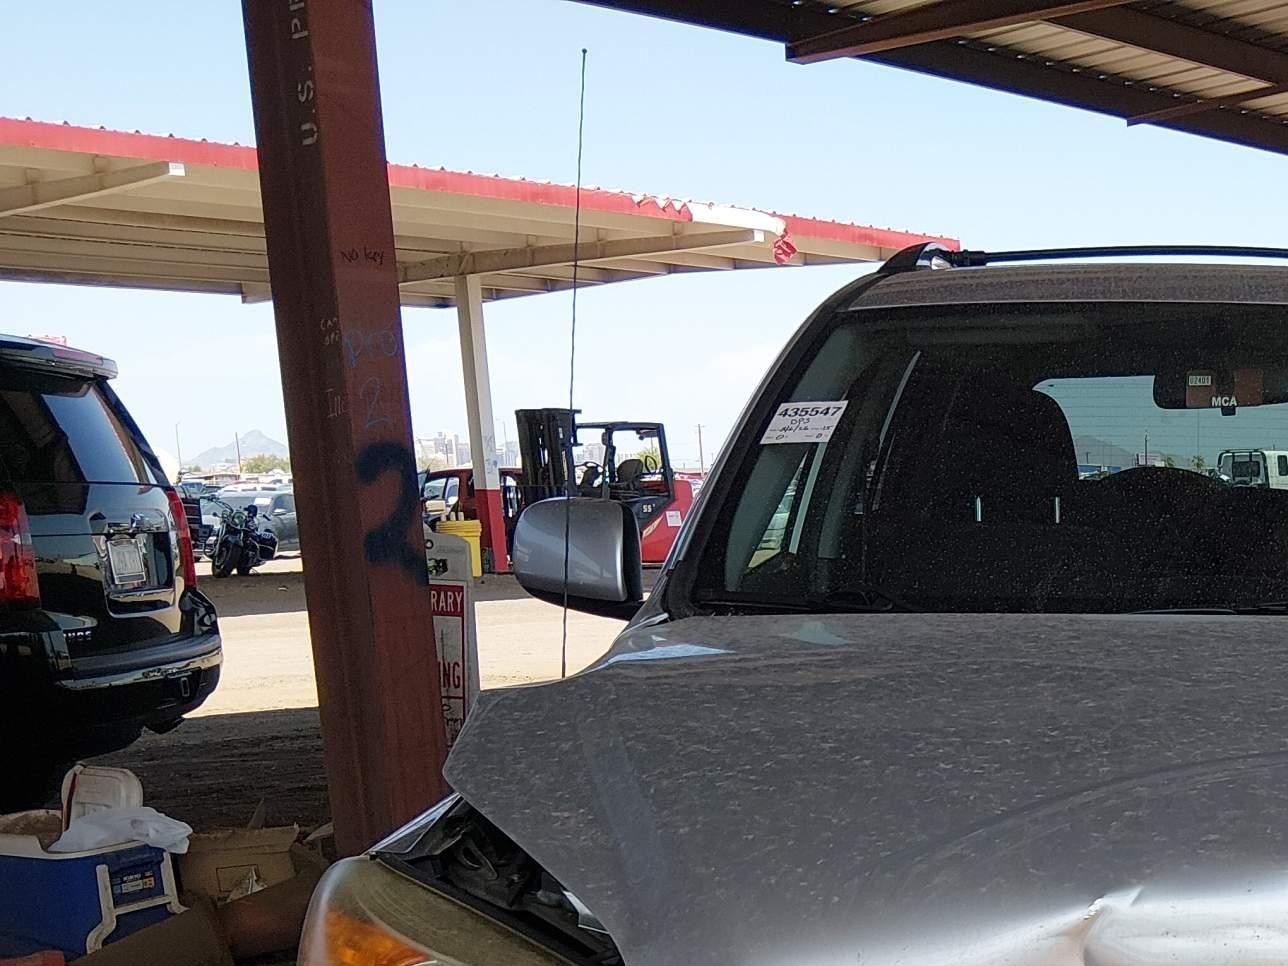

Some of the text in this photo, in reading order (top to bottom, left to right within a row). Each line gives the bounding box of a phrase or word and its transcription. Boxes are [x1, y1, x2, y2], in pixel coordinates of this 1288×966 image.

[1211, 396, 1238, 407] MCA
[777, 406, 843, 418] 435547
[431, 591, 463, 612] RARY
